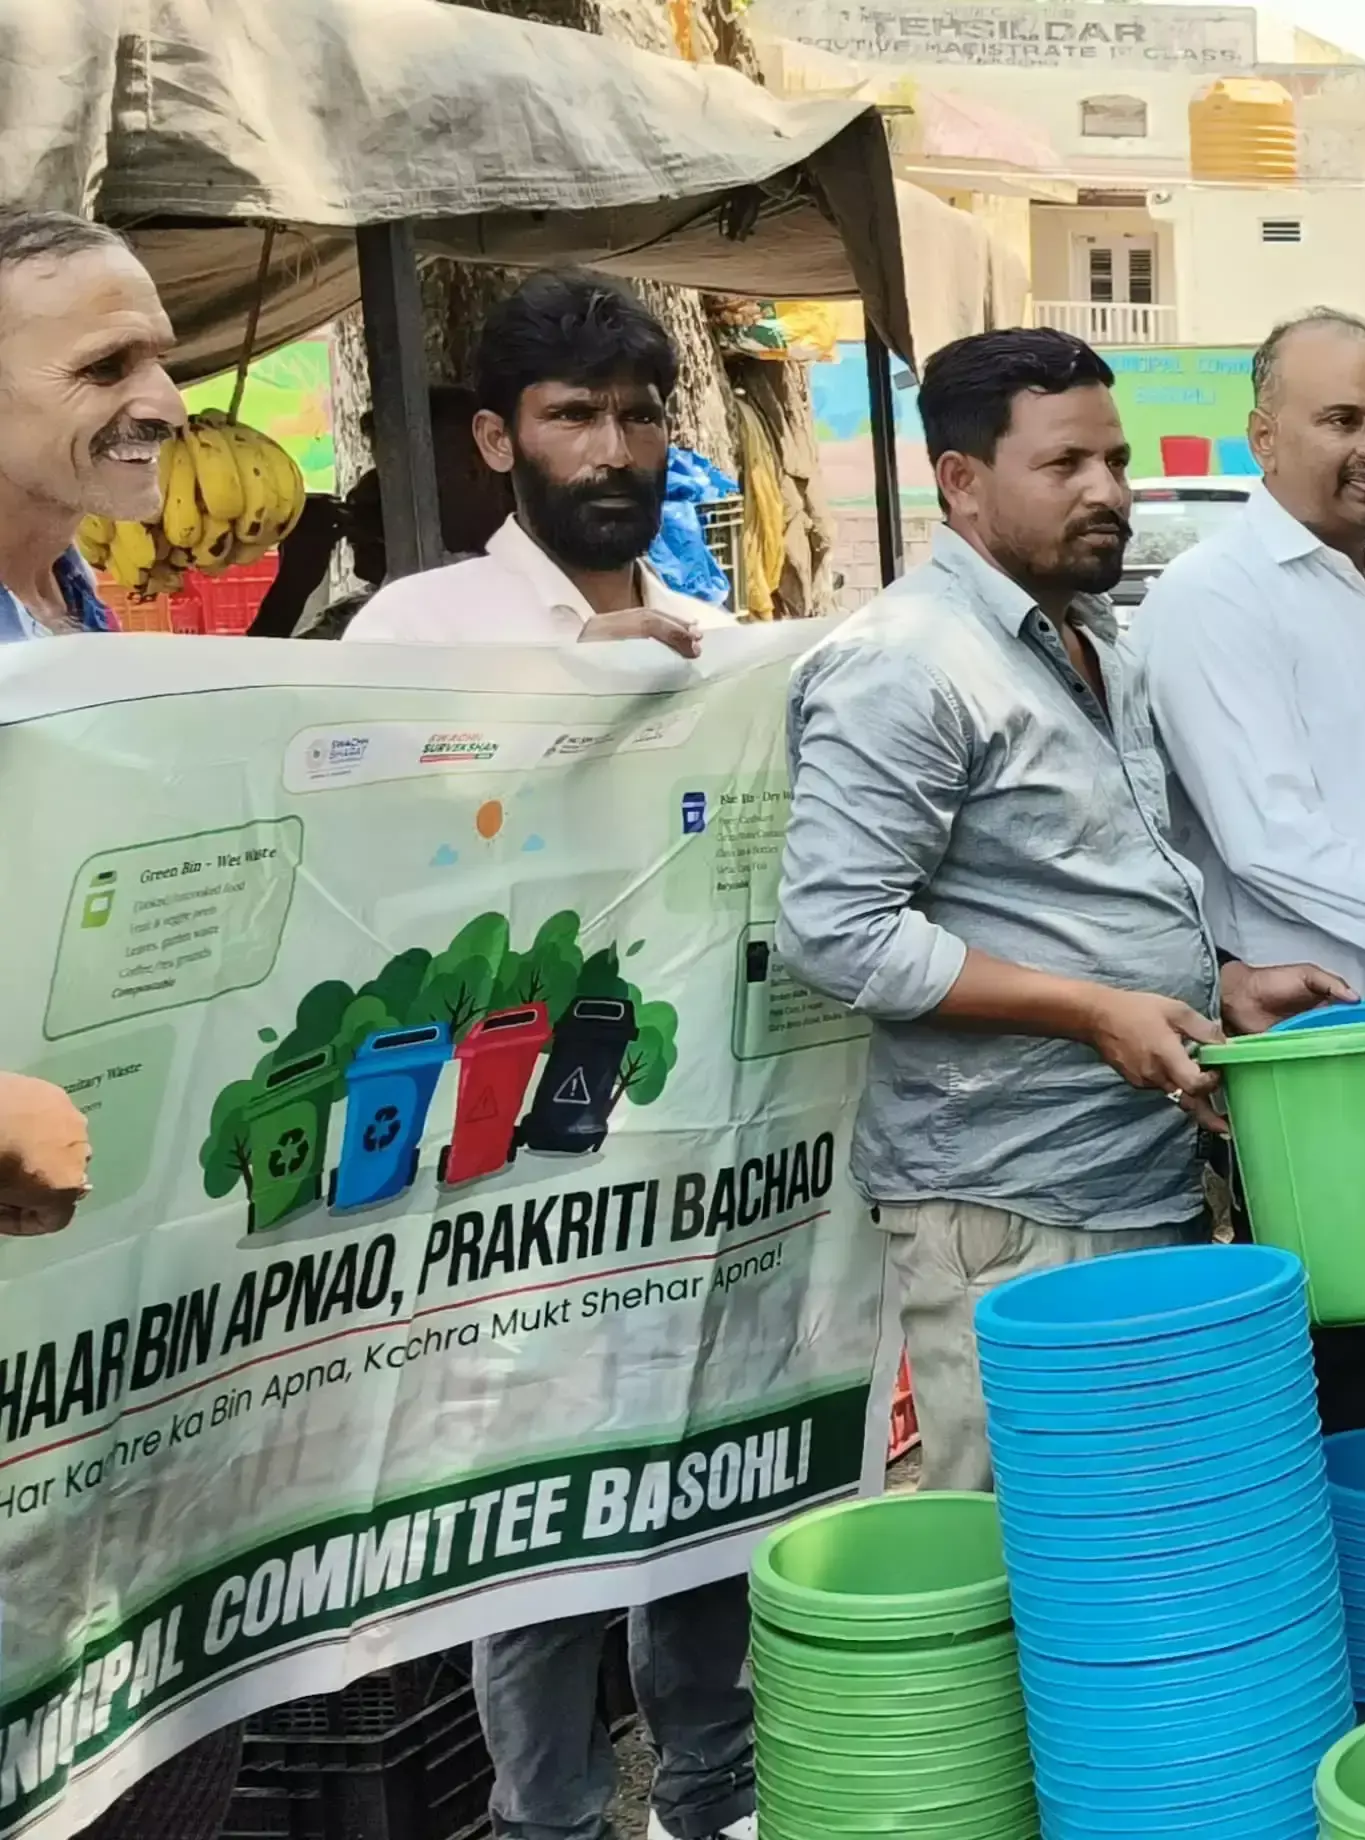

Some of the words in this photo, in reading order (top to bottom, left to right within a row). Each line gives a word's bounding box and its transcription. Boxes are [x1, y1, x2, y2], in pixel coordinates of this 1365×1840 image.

[140, 866, 178, 884] Green
[181, 861, 202, 875] Bin
[0, 1317, 129, 1442] HAAR
[129, 1282, 221, 1392] BIN
[220, 1233, 404, 1356] APNAO,
[417, 1178, 660, 1295] PRAKRITI
[669, 1132, 834, 1243] BACHAO
[169, 1410, 205, 1445] ka
[211, 1387, 253, 1428] Bin
[261, 1356, 353, 1412] Apna,
[491, 1298, 570, 1340] Mukt
[581, 1273, 703, 1318] Shehar
[710, 1242, 783, 1294] Apna!
[203, 1473, 571, 1656] COMMITTEE
[582, 1419, 813, 1541] BASOHLI
